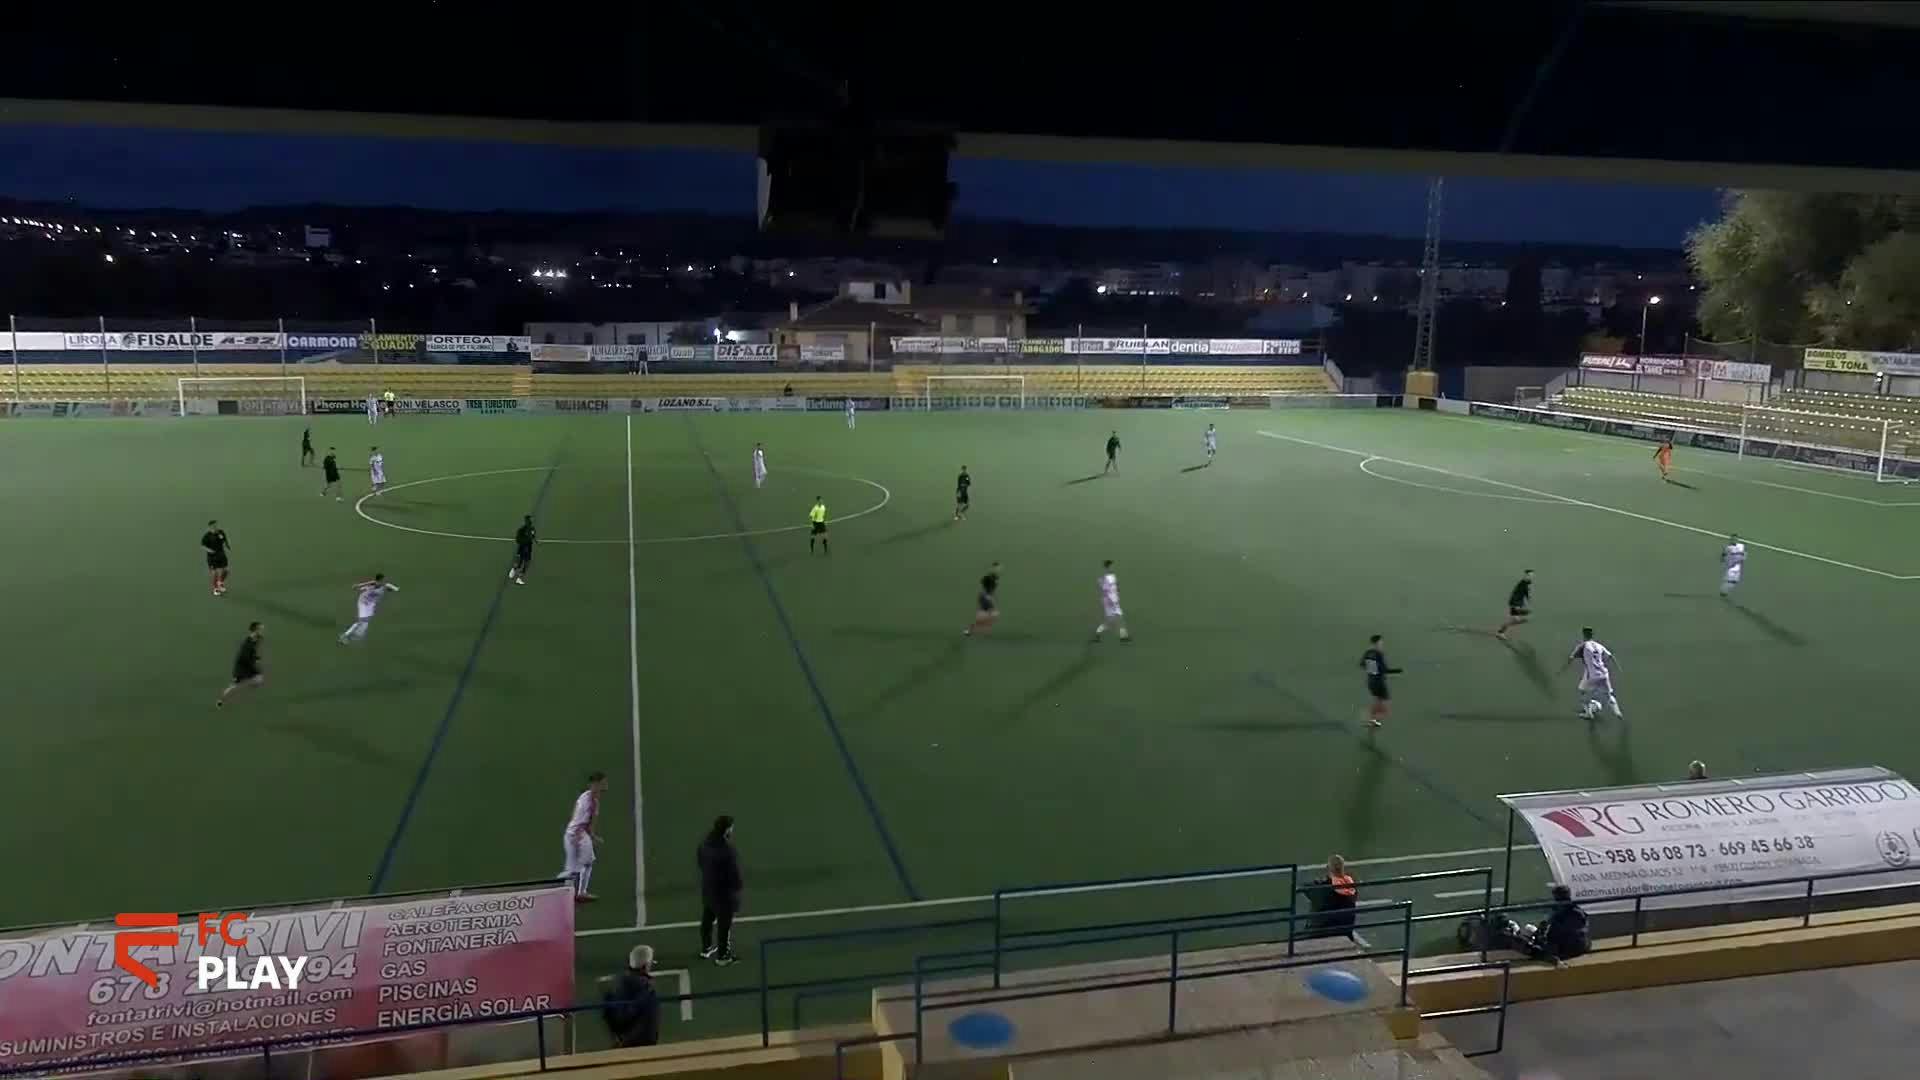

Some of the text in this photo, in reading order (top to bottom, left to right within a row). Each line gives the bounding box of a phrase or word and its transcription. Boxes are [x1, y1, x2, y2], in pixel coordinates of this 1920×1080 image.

[137, 334, 213, 346] FISALDE
[288, 336, 358, 348] CARMONA
[433, 336, 492, 344] ORTEGA
[1170, 341, 1209, 352] dentia
[313, 400, 350, 409] Phone
[415, 400, 460, 408] VELASCO
[658, 399, 697, 407] LOZANO
[1642, 782, 1908, 821] ROMERO GARRIDO
[1564, 835, 1814, 867] TEL: 958 66 08 73 669 45 66 38
[385, 915, 523, 938] AEROTERMIA
[383, 930, 518, 957] FONTANERÍA
[380, 960, 427, 979] GAS
[88, 974, 171, 1005] 678
[378, 978, 478, 1003] PISCINAS
[87, 986, 354, 1026] fontatrivi@hotmail.com
[377, 995, 551, 1028] ENERGÍA SOLAR
[0, 1008, 337, 1056] SUMINISTROS E INSTALACIONES
